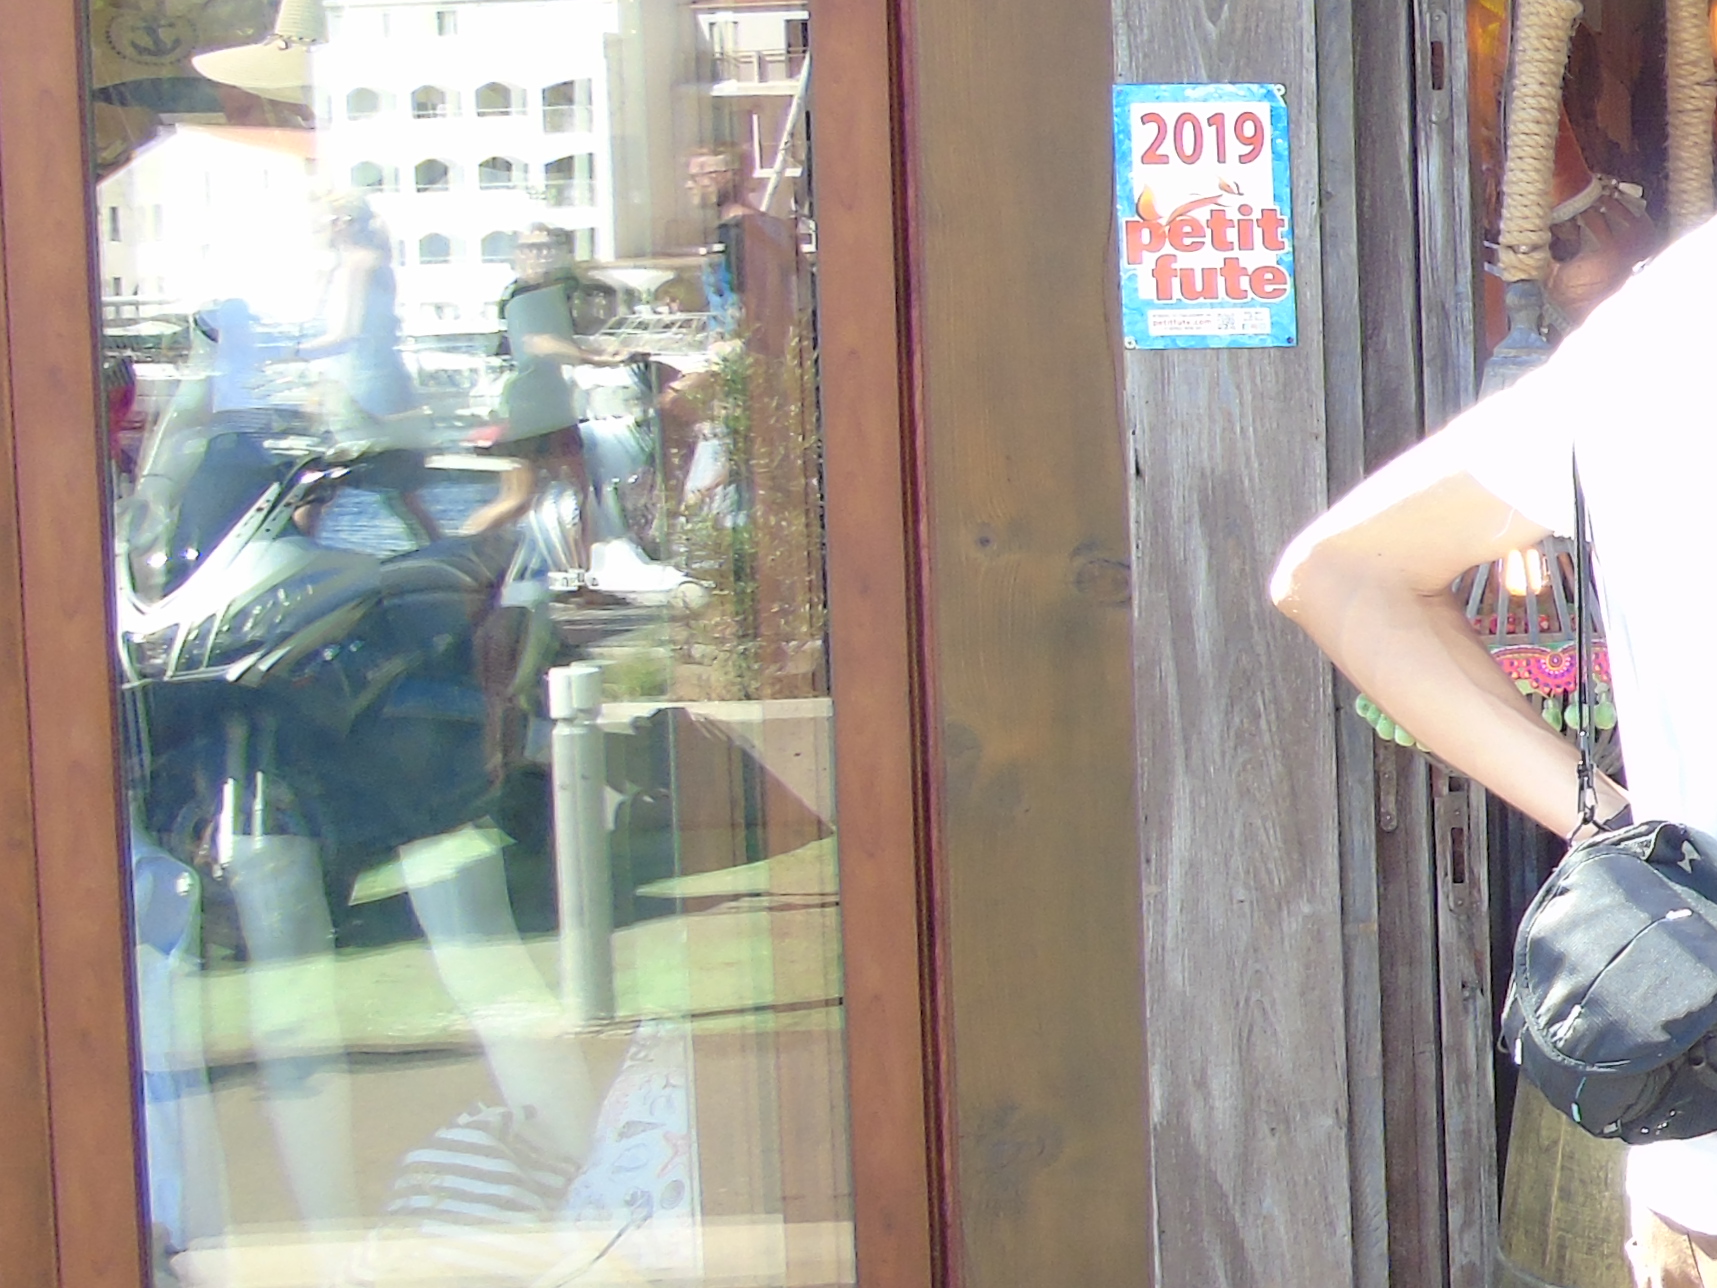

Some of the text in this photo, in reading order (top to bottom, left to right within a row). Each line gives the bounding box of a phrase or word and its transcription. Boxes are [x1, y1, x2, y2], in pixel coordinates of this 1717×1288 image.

[1140, 111, 1265, 165] 2019
[1125, 204, 1286, 266] petit
[1152, 254, 1288, 301] fute
